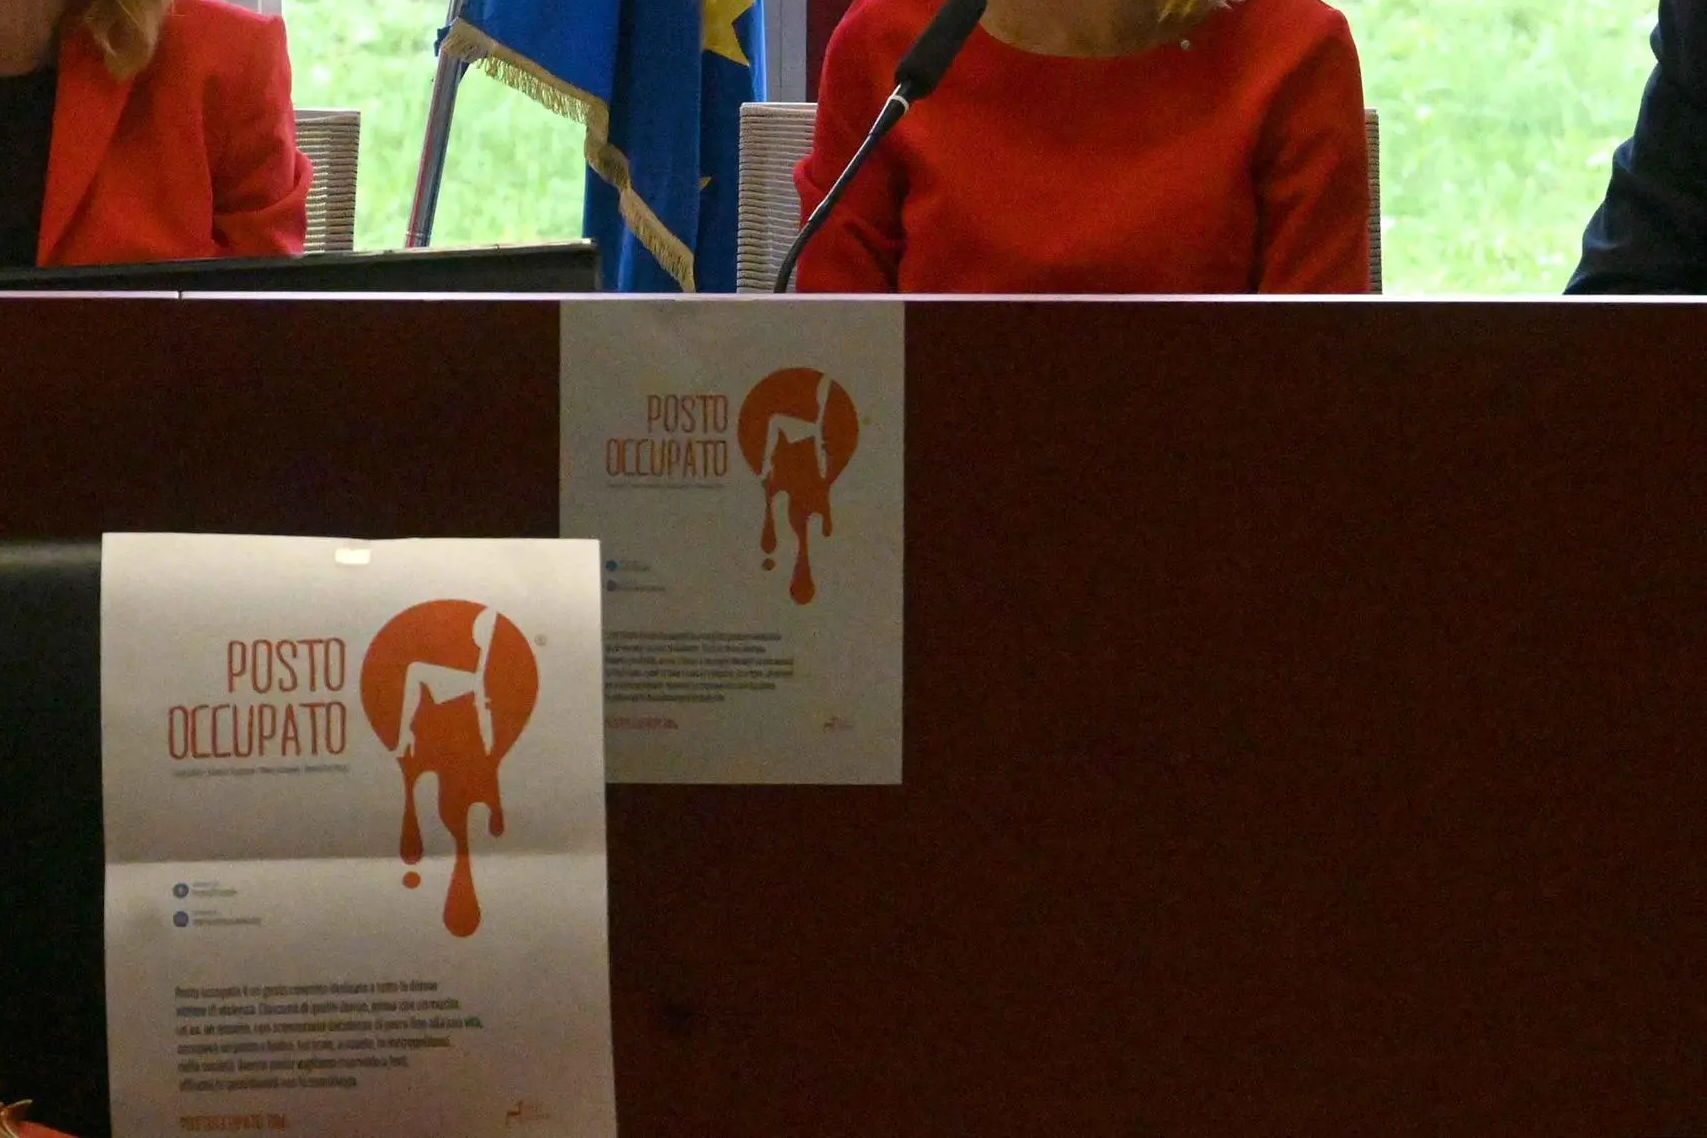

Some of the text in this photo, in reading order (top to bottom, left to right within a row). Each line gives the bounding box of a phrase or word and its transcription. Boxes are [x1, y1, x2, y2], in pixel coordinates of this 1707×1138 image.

[646, 394, 728, 433] POSTO
[606, 438, 728, 478] OCCUPATO
[227, 638, 346, 693] POSTO
[168, 701, 347, 759] OCCUPATO
